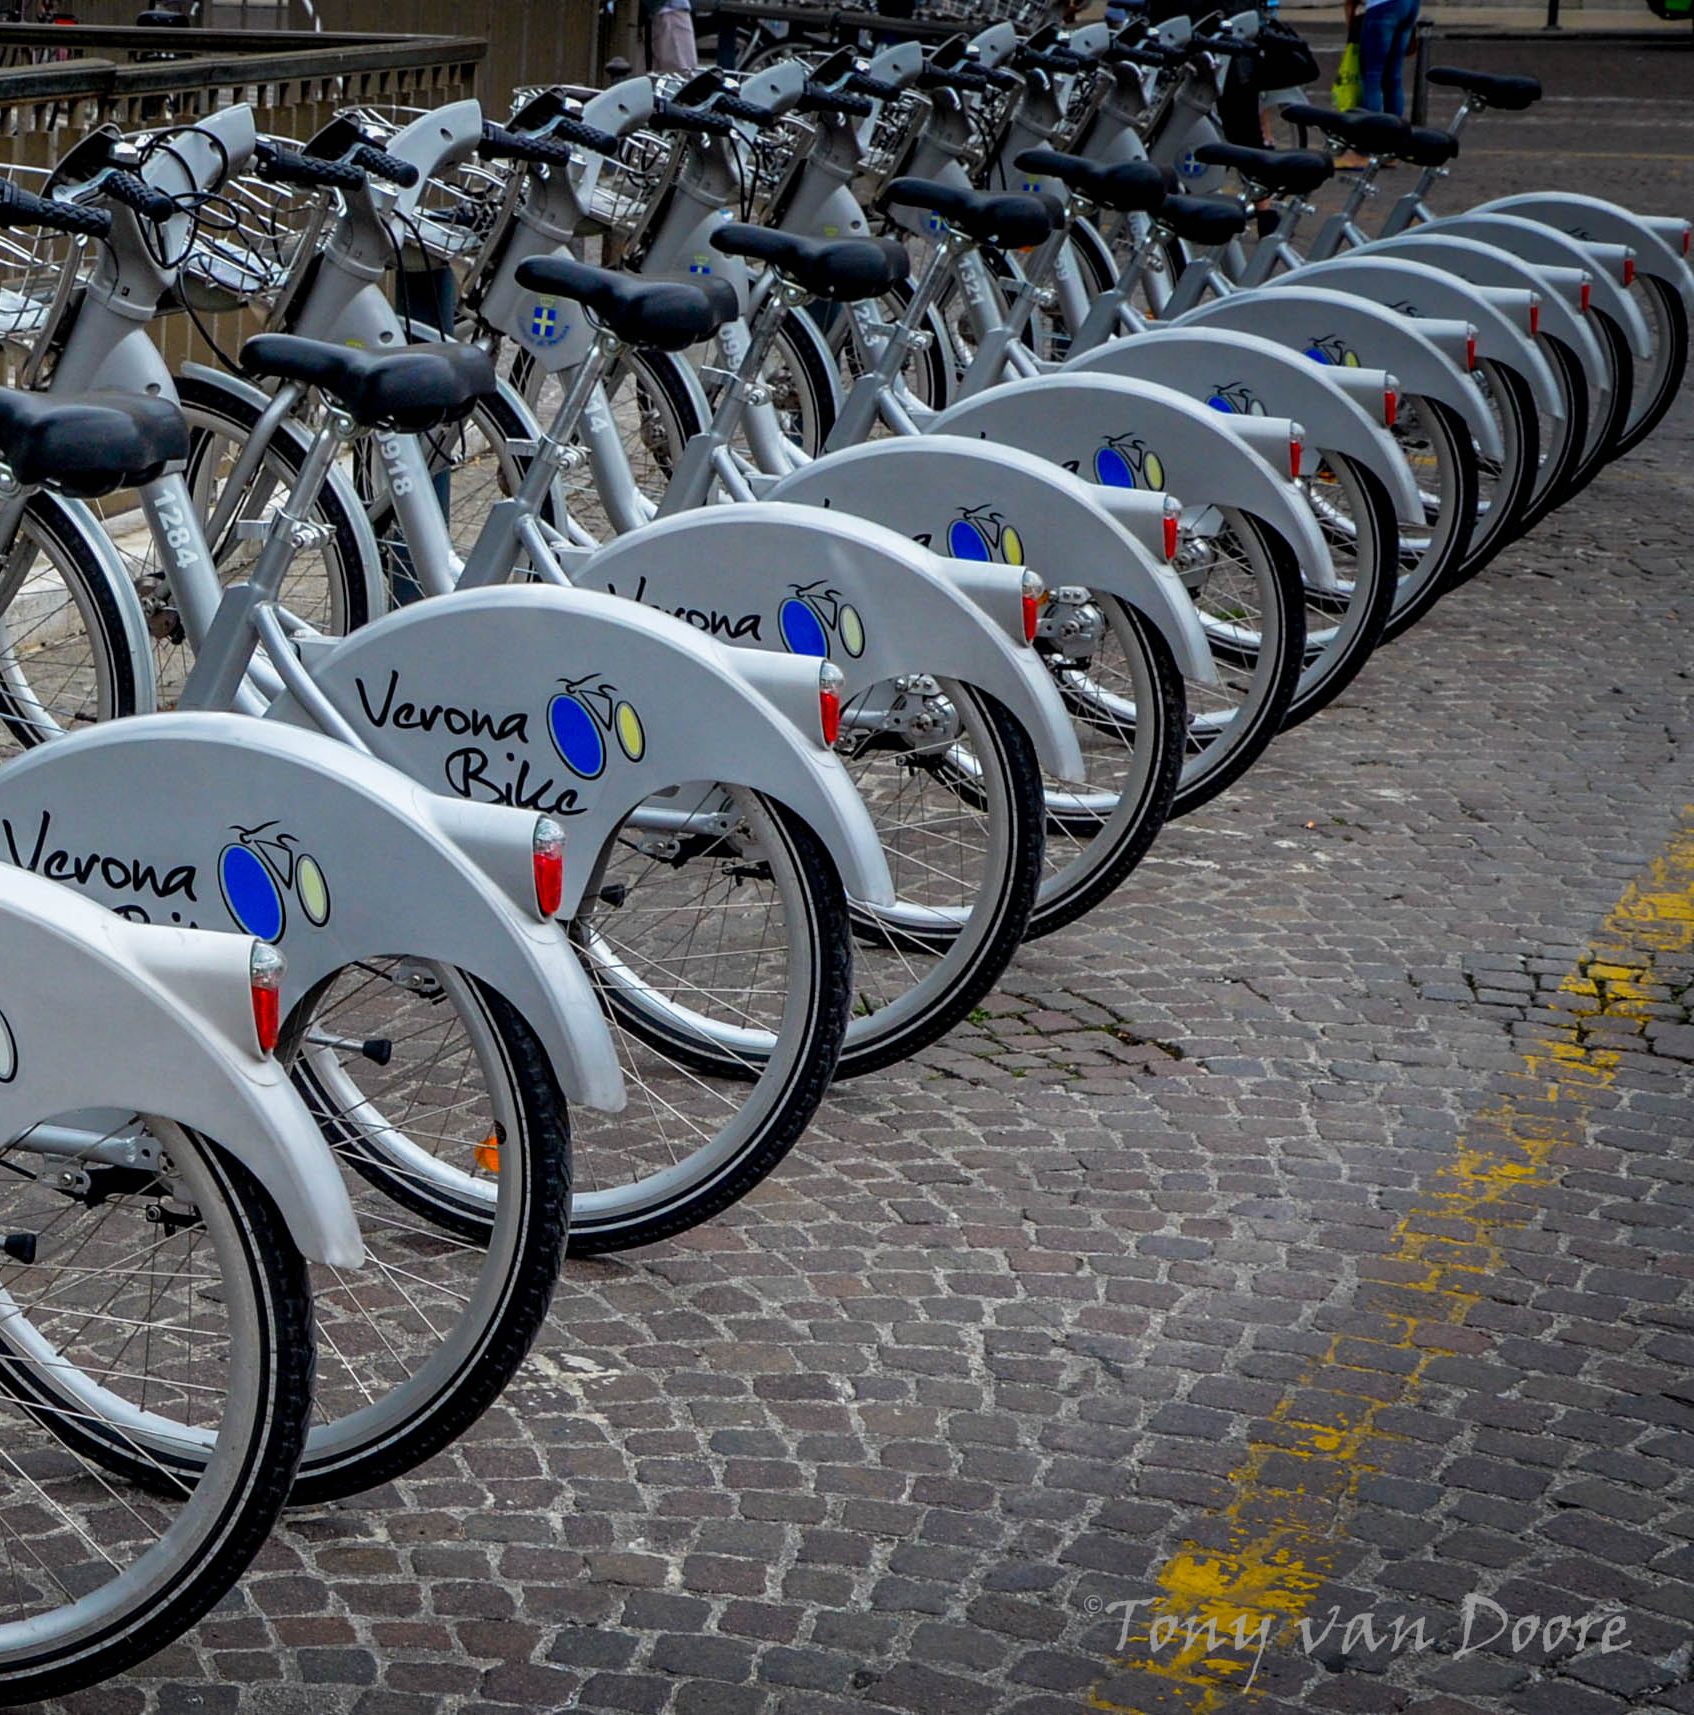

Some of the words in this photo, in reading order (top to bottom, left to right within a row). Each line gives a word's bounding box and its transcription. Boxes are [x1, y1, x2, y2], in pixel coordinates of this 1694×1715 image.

[153, 488, 199, 569] 1284
[354, 669, 530, 744] Verona
[444, 746, 589, 817] Bike
[1, 809, 199, 903] Verona
